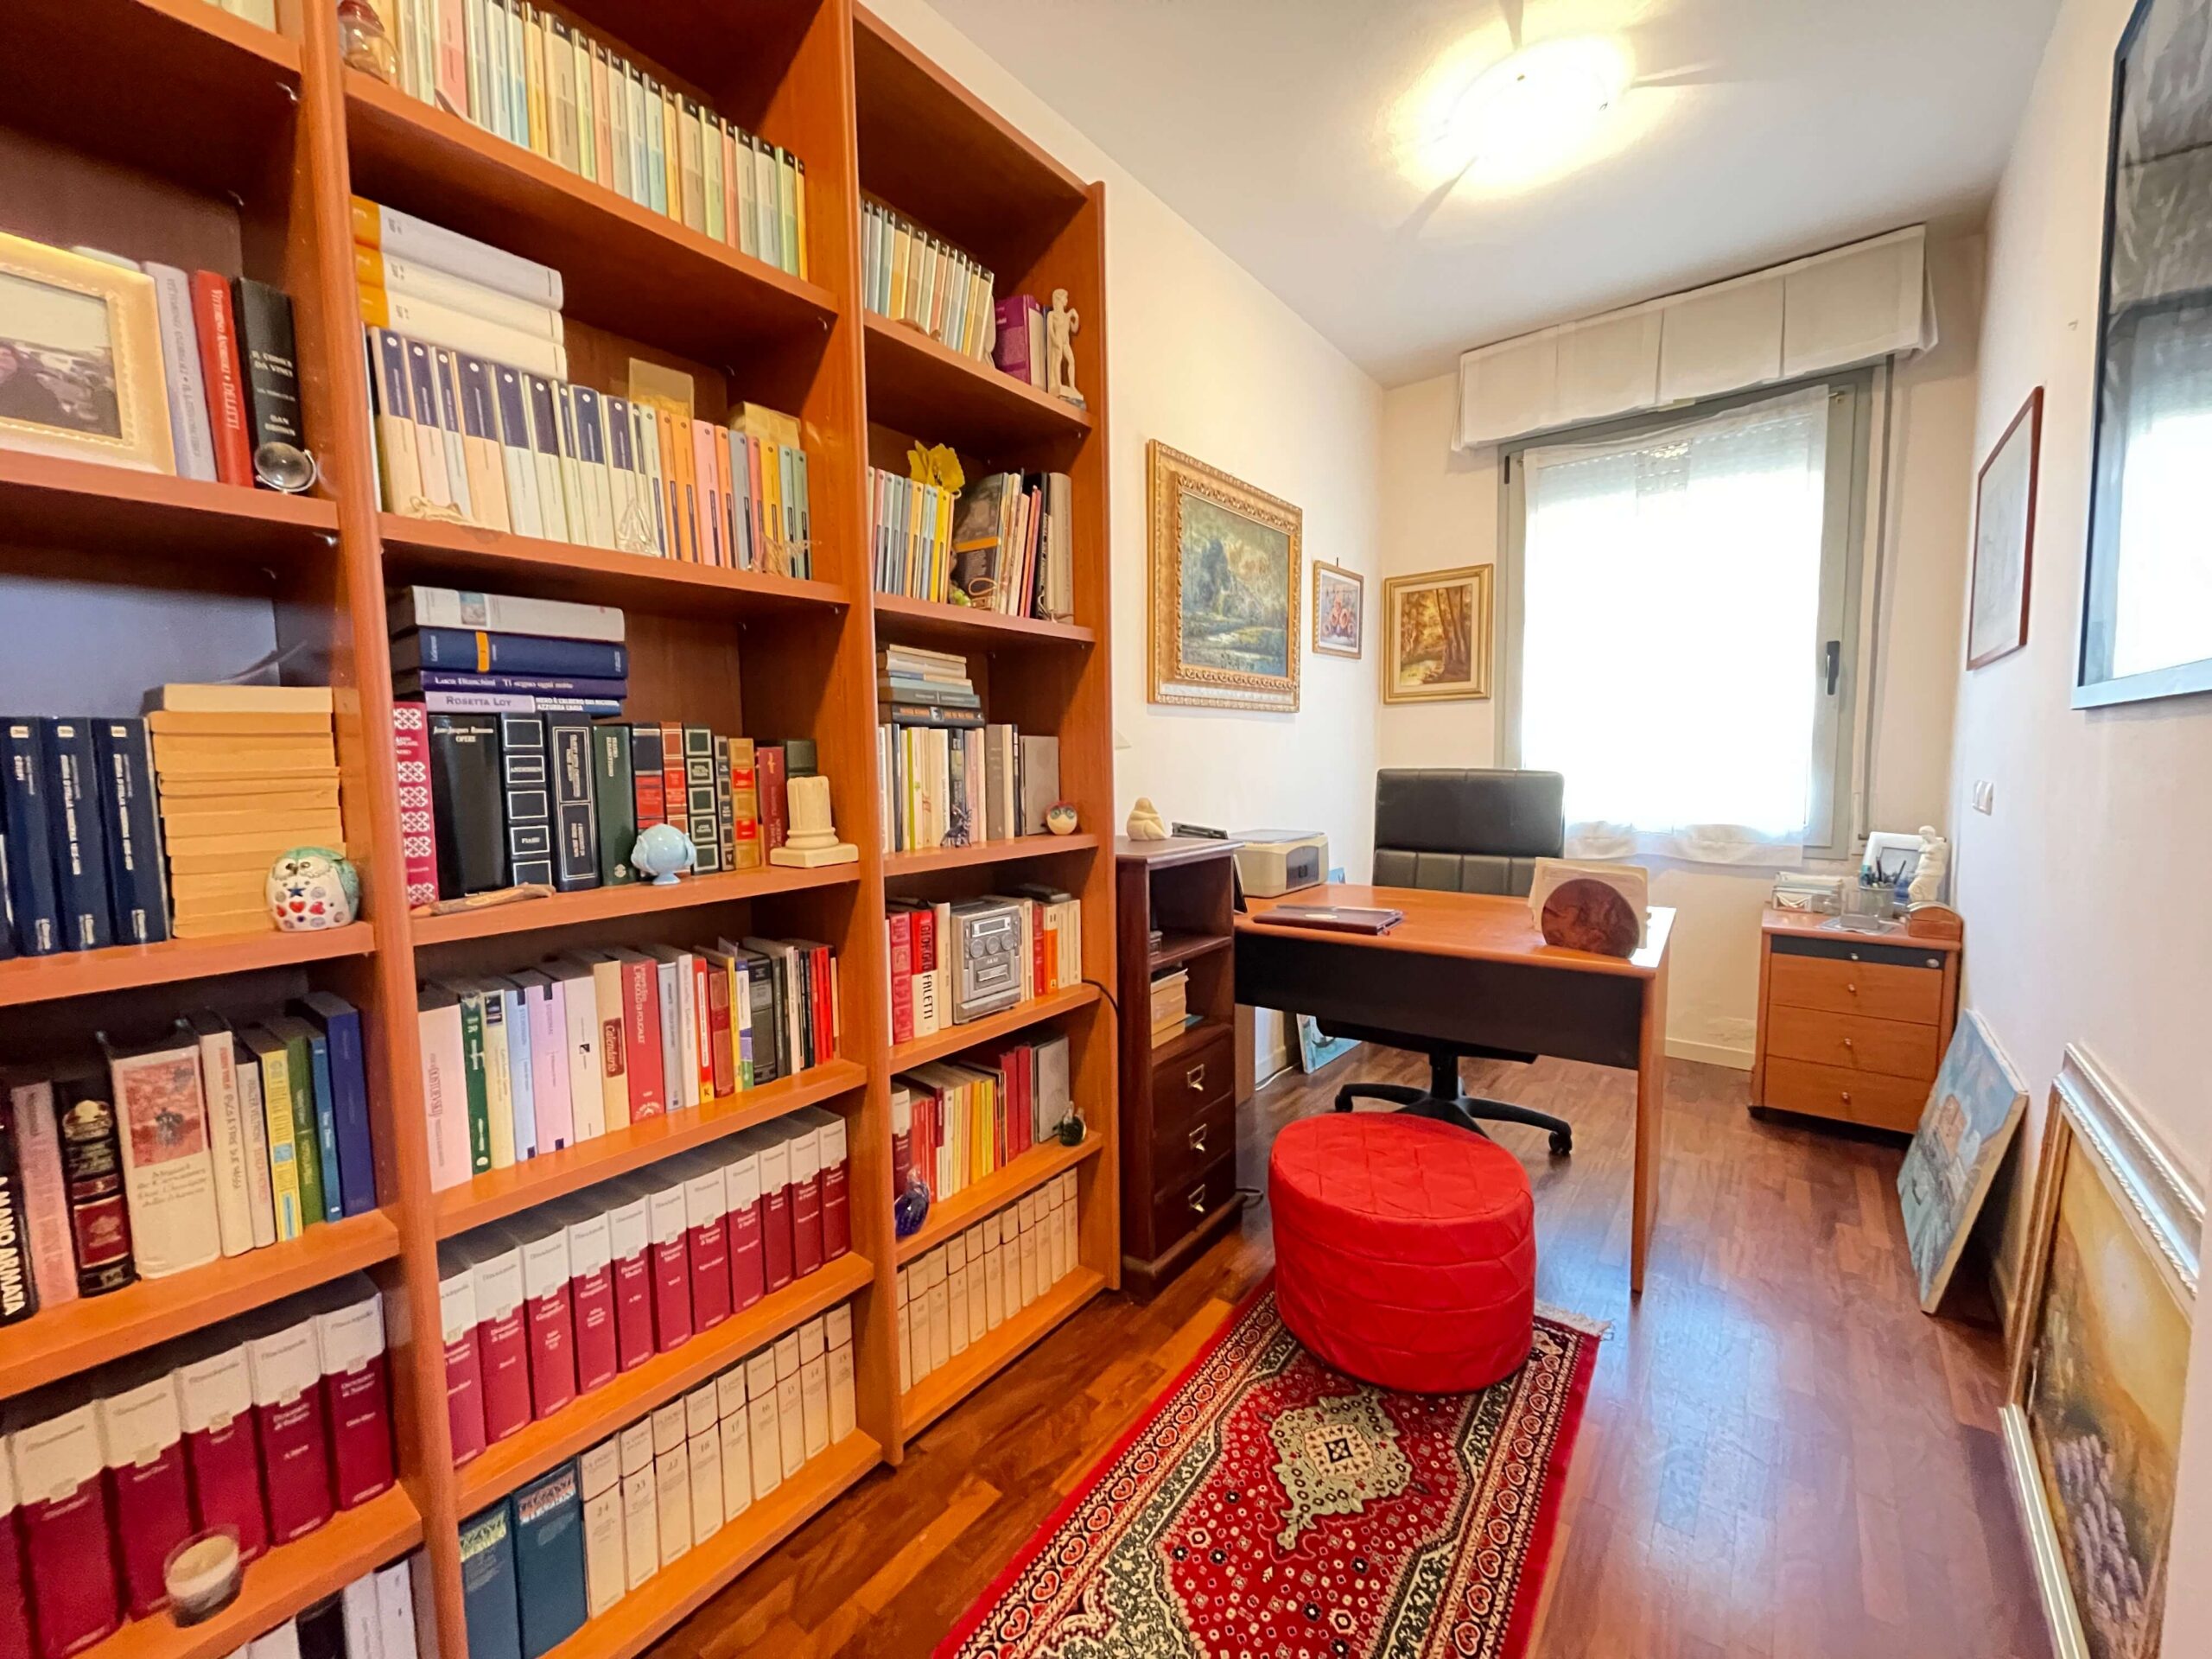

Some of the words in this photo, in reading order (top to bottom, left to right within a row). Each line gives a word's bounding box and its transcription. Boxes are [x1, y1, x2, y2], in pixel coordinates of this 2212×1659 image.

[222, 383, 240, 429] DELITTI
[446, 696, 490, 706] ROSETTA
[493, 696, 512, 707] LOY
[503, 678, 512, 687] Ti
[921, 925, 931, 970] GIORGIO
[923, 975, 933, 1020] FALETTI
[606, 1024, 617, 1072] Calendario
[0, 1247, 25, 1316] ARMATA
